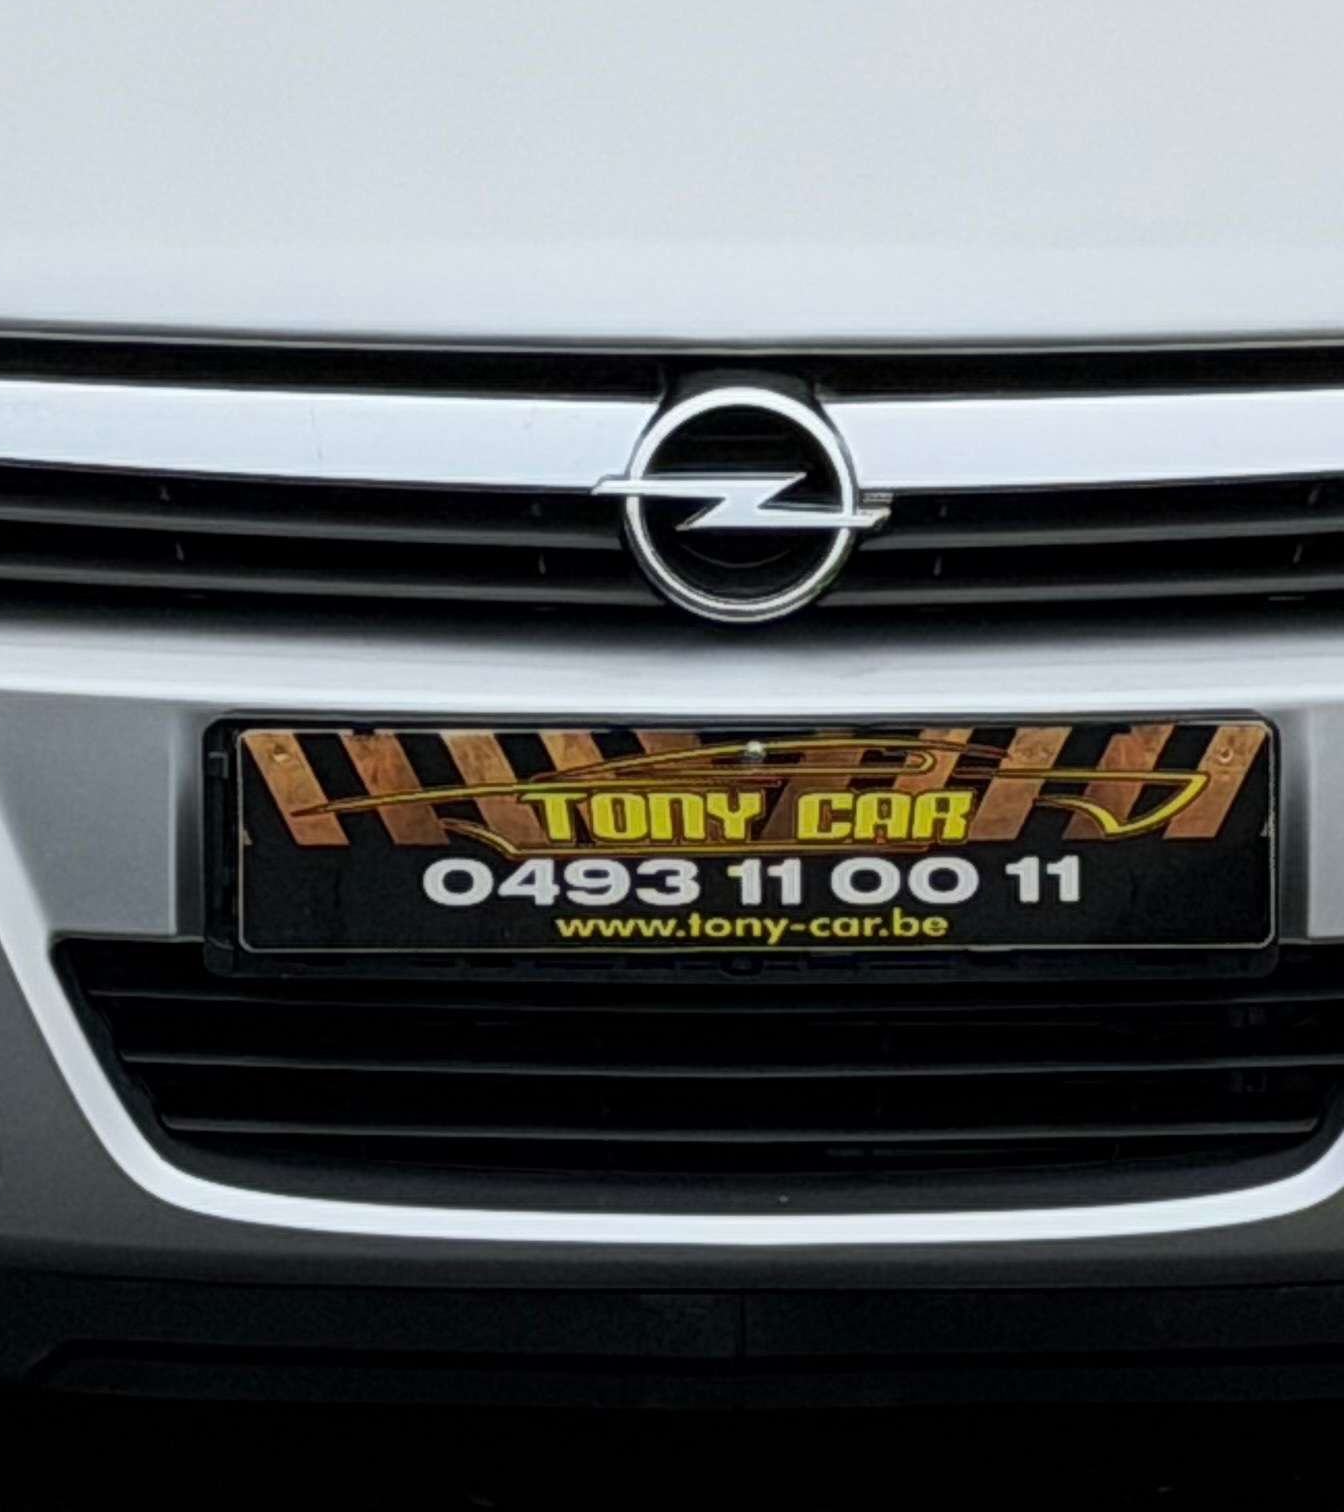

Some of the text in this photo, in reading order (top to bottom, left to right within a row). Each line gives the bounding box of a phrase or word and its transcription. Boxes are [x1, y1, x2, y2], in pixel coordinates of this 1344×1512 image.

[517, 789, 974, 843] TONY CAR
[421, 855, 1081, 908] 0493 11 00 11
[555, 909, 949, 945] www.tony-car.be
